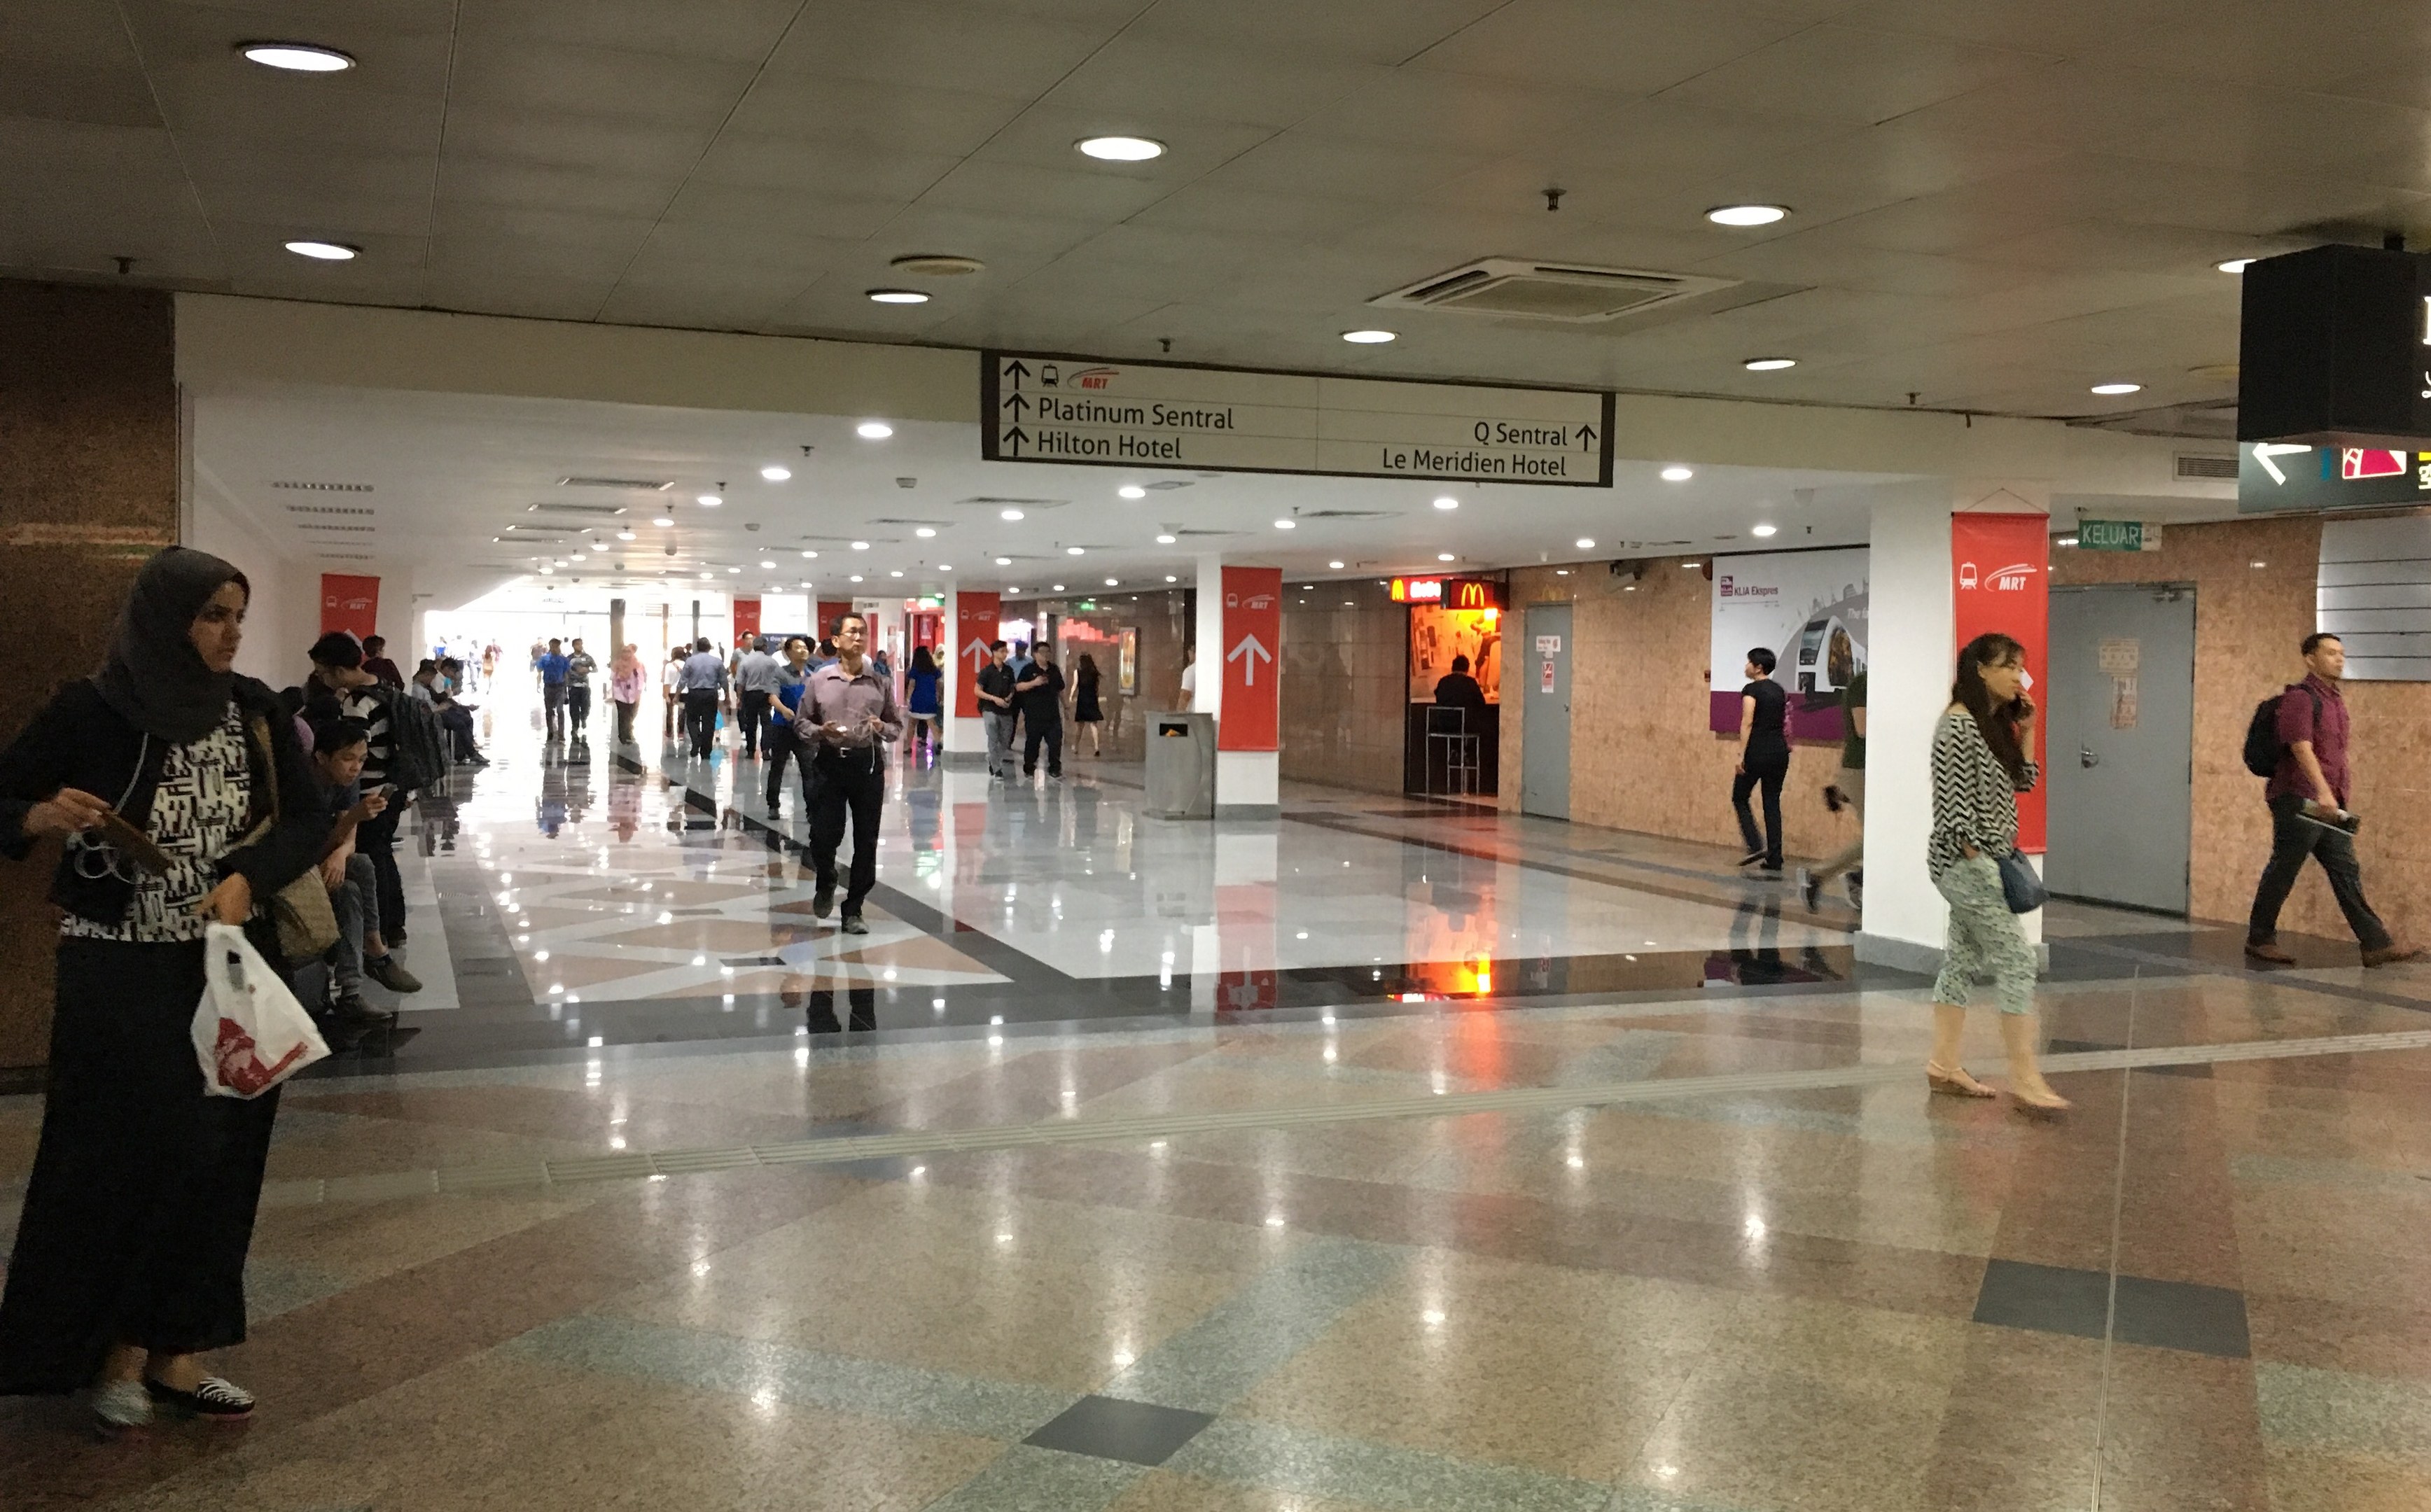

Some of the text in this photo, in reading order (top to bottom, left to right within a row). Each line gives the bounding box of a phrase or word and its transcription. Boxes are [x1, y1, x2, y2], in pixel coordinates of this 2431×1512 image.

[1081, 377, 1108, 389] MRT
[1039, 397, 1234, 429] Platinum Sentral
[1038, 430, 1182, 459] Hilton Hotel
[1474, 421, 1568, 447] Q Sentral
[1383, 448, 1567, 477] Le Meridien Hotel
[2082, 524, 2140, 545] KELUAR
[1734, 586, 1778, 597] KLIA Ekspres
[1998, 576, 2027, 591] MRT
